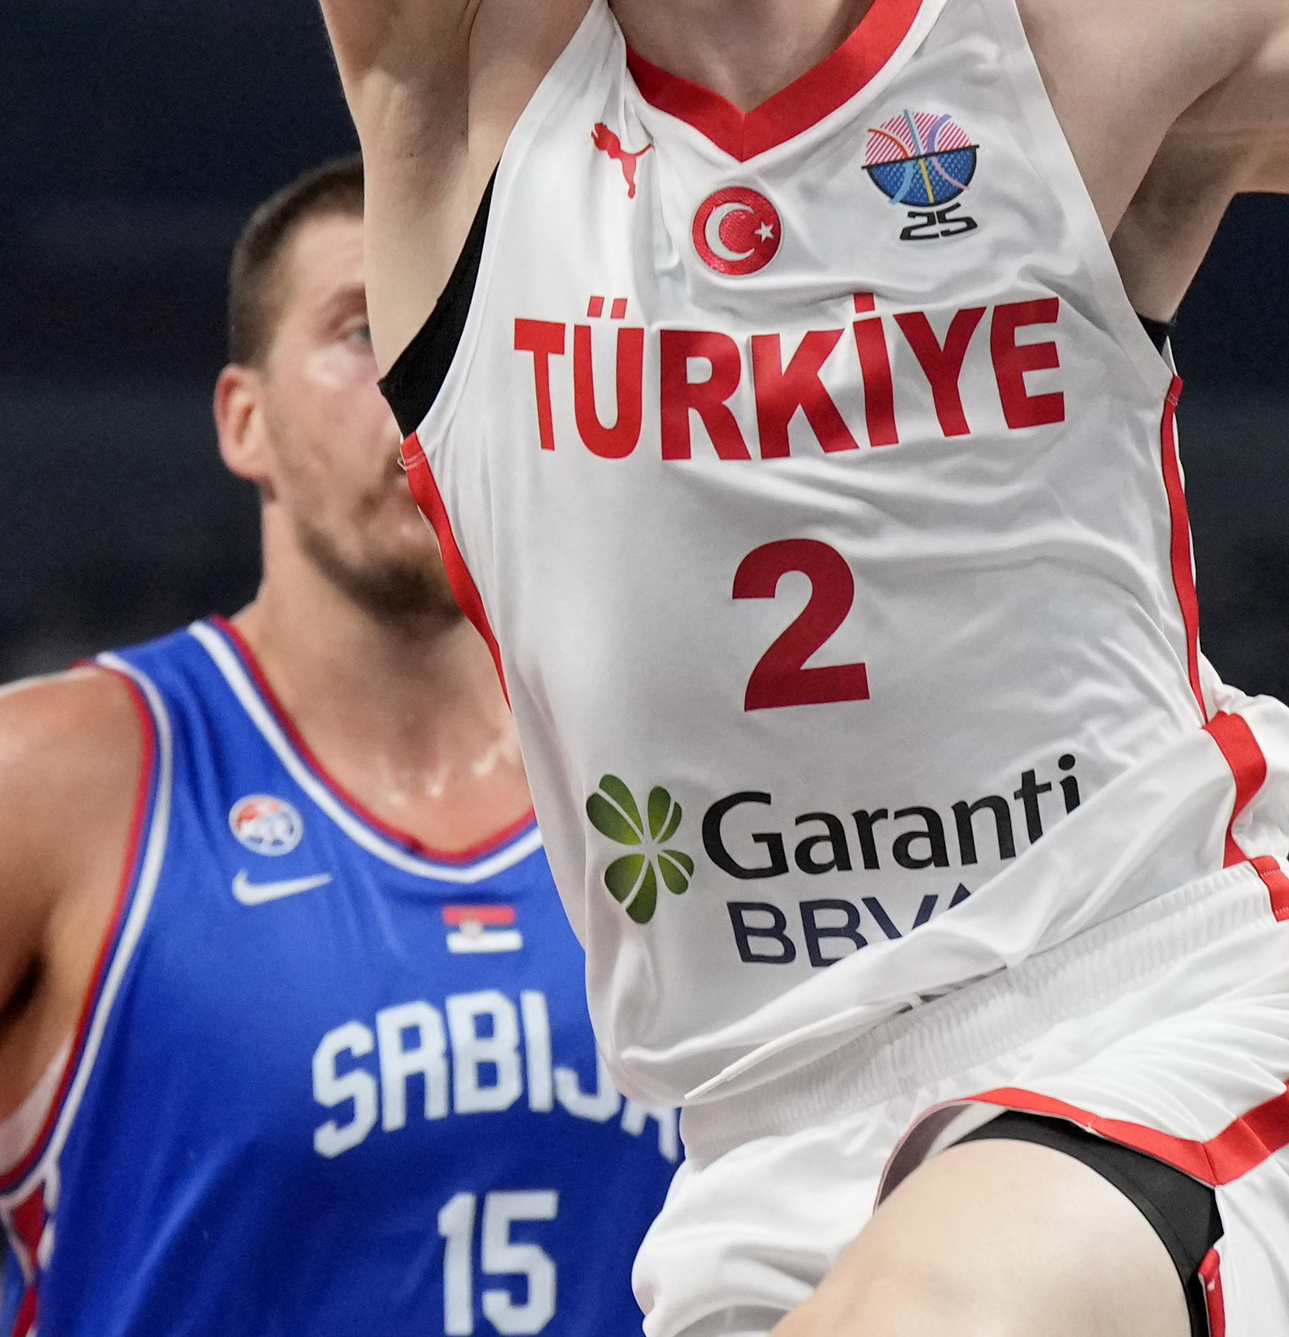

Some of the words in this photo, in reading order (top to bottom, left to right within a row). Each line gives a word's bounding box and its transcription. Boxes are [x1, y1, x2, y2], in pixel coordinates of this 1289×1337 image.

[900, 203, 978, 240] 25
[514, 293, 1065, 461] TÜRKİYE
[731, 538, 871, 712] 2
[702, 754, 1080, 880] Garanti
[438, 1190, 558, 1336] 15
